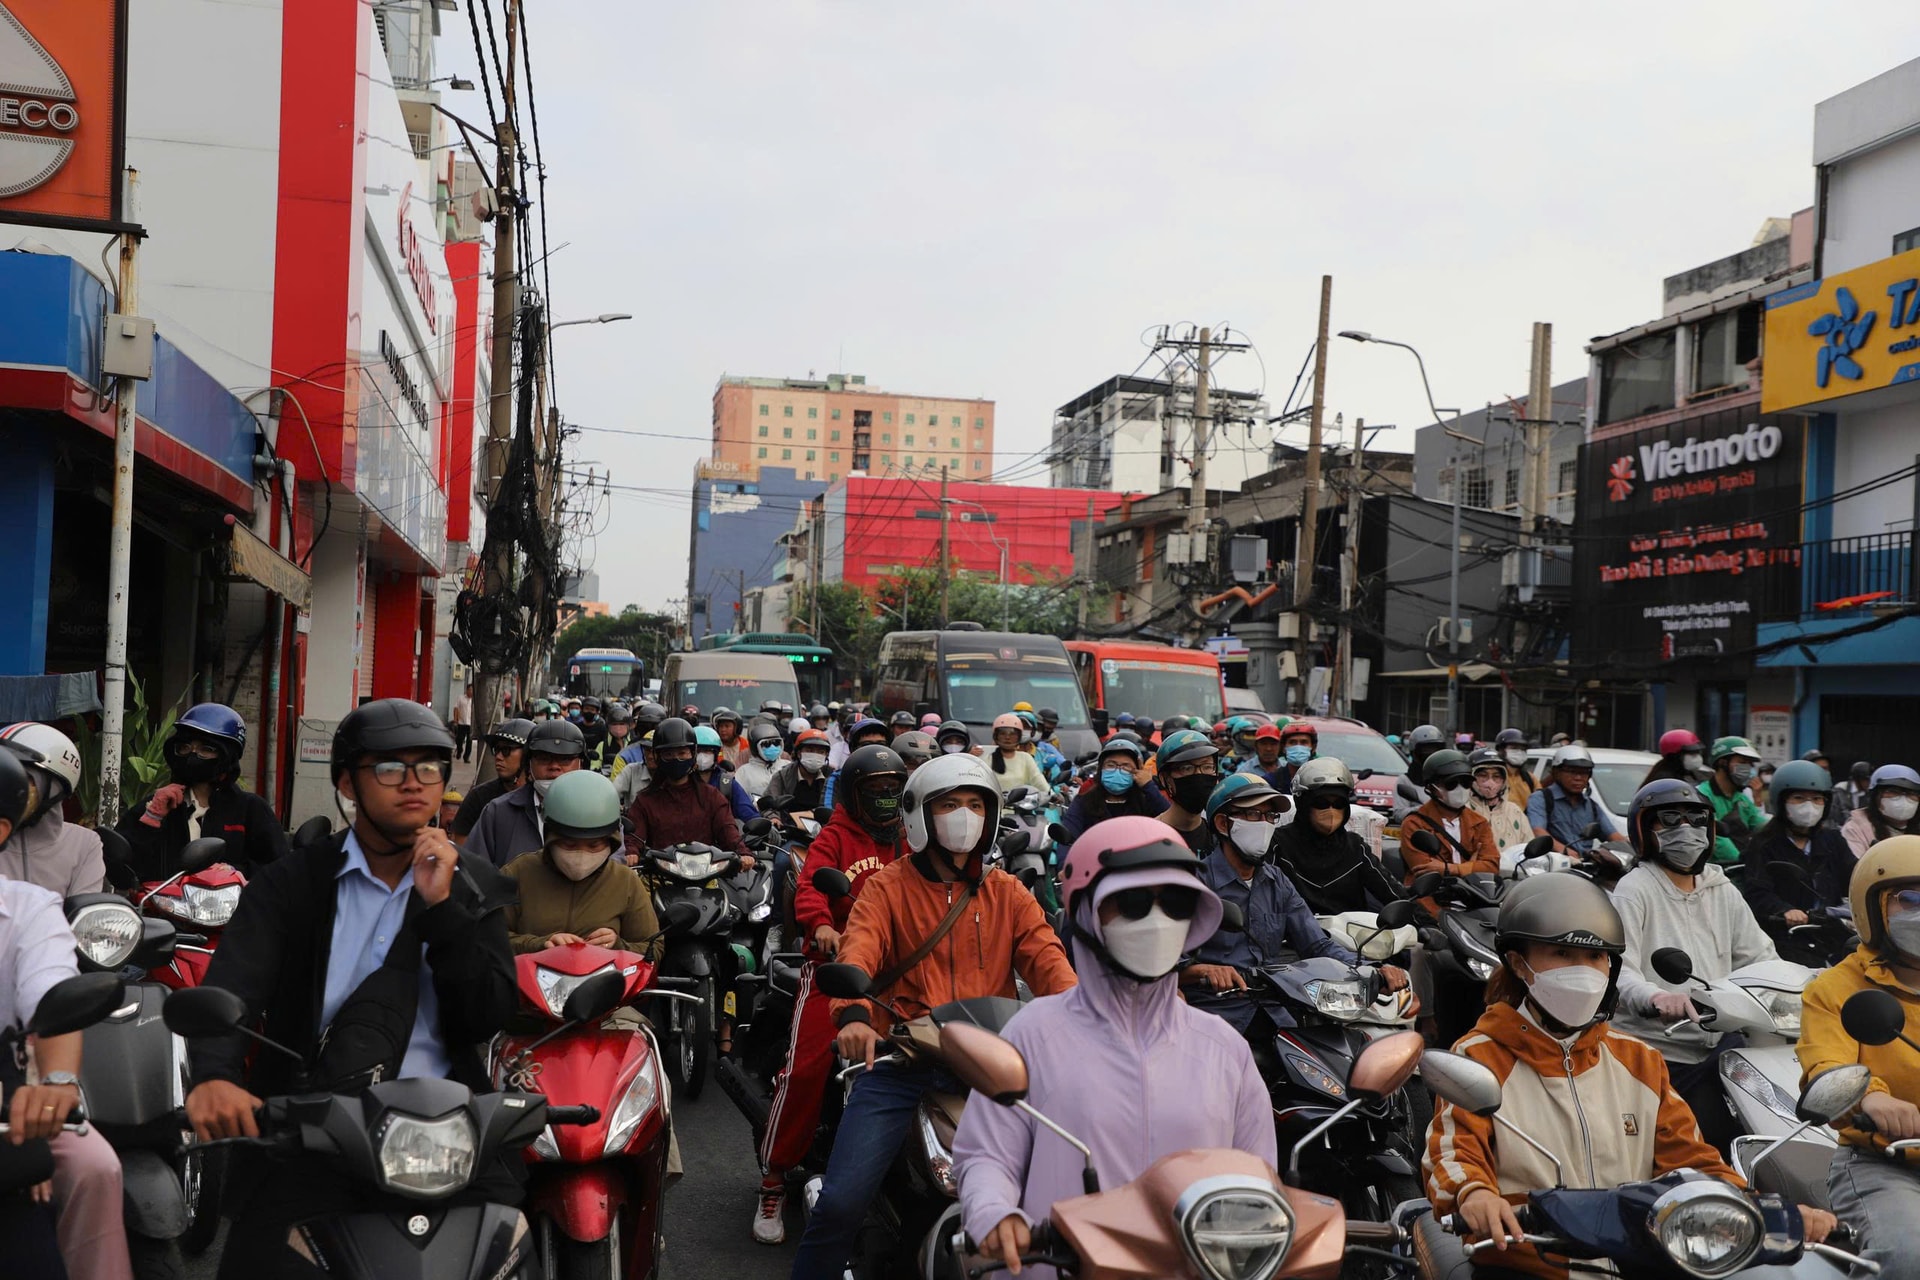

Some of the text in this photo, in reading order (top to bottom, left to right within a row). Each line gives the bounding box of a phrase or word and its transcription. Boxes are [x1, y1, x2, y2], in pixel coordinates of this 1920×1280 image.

[1639, 423, 1783, 482] Vietmoto
[1652, 557, 1665, 577] &
[1557, 932, 1604, 946] Andes
